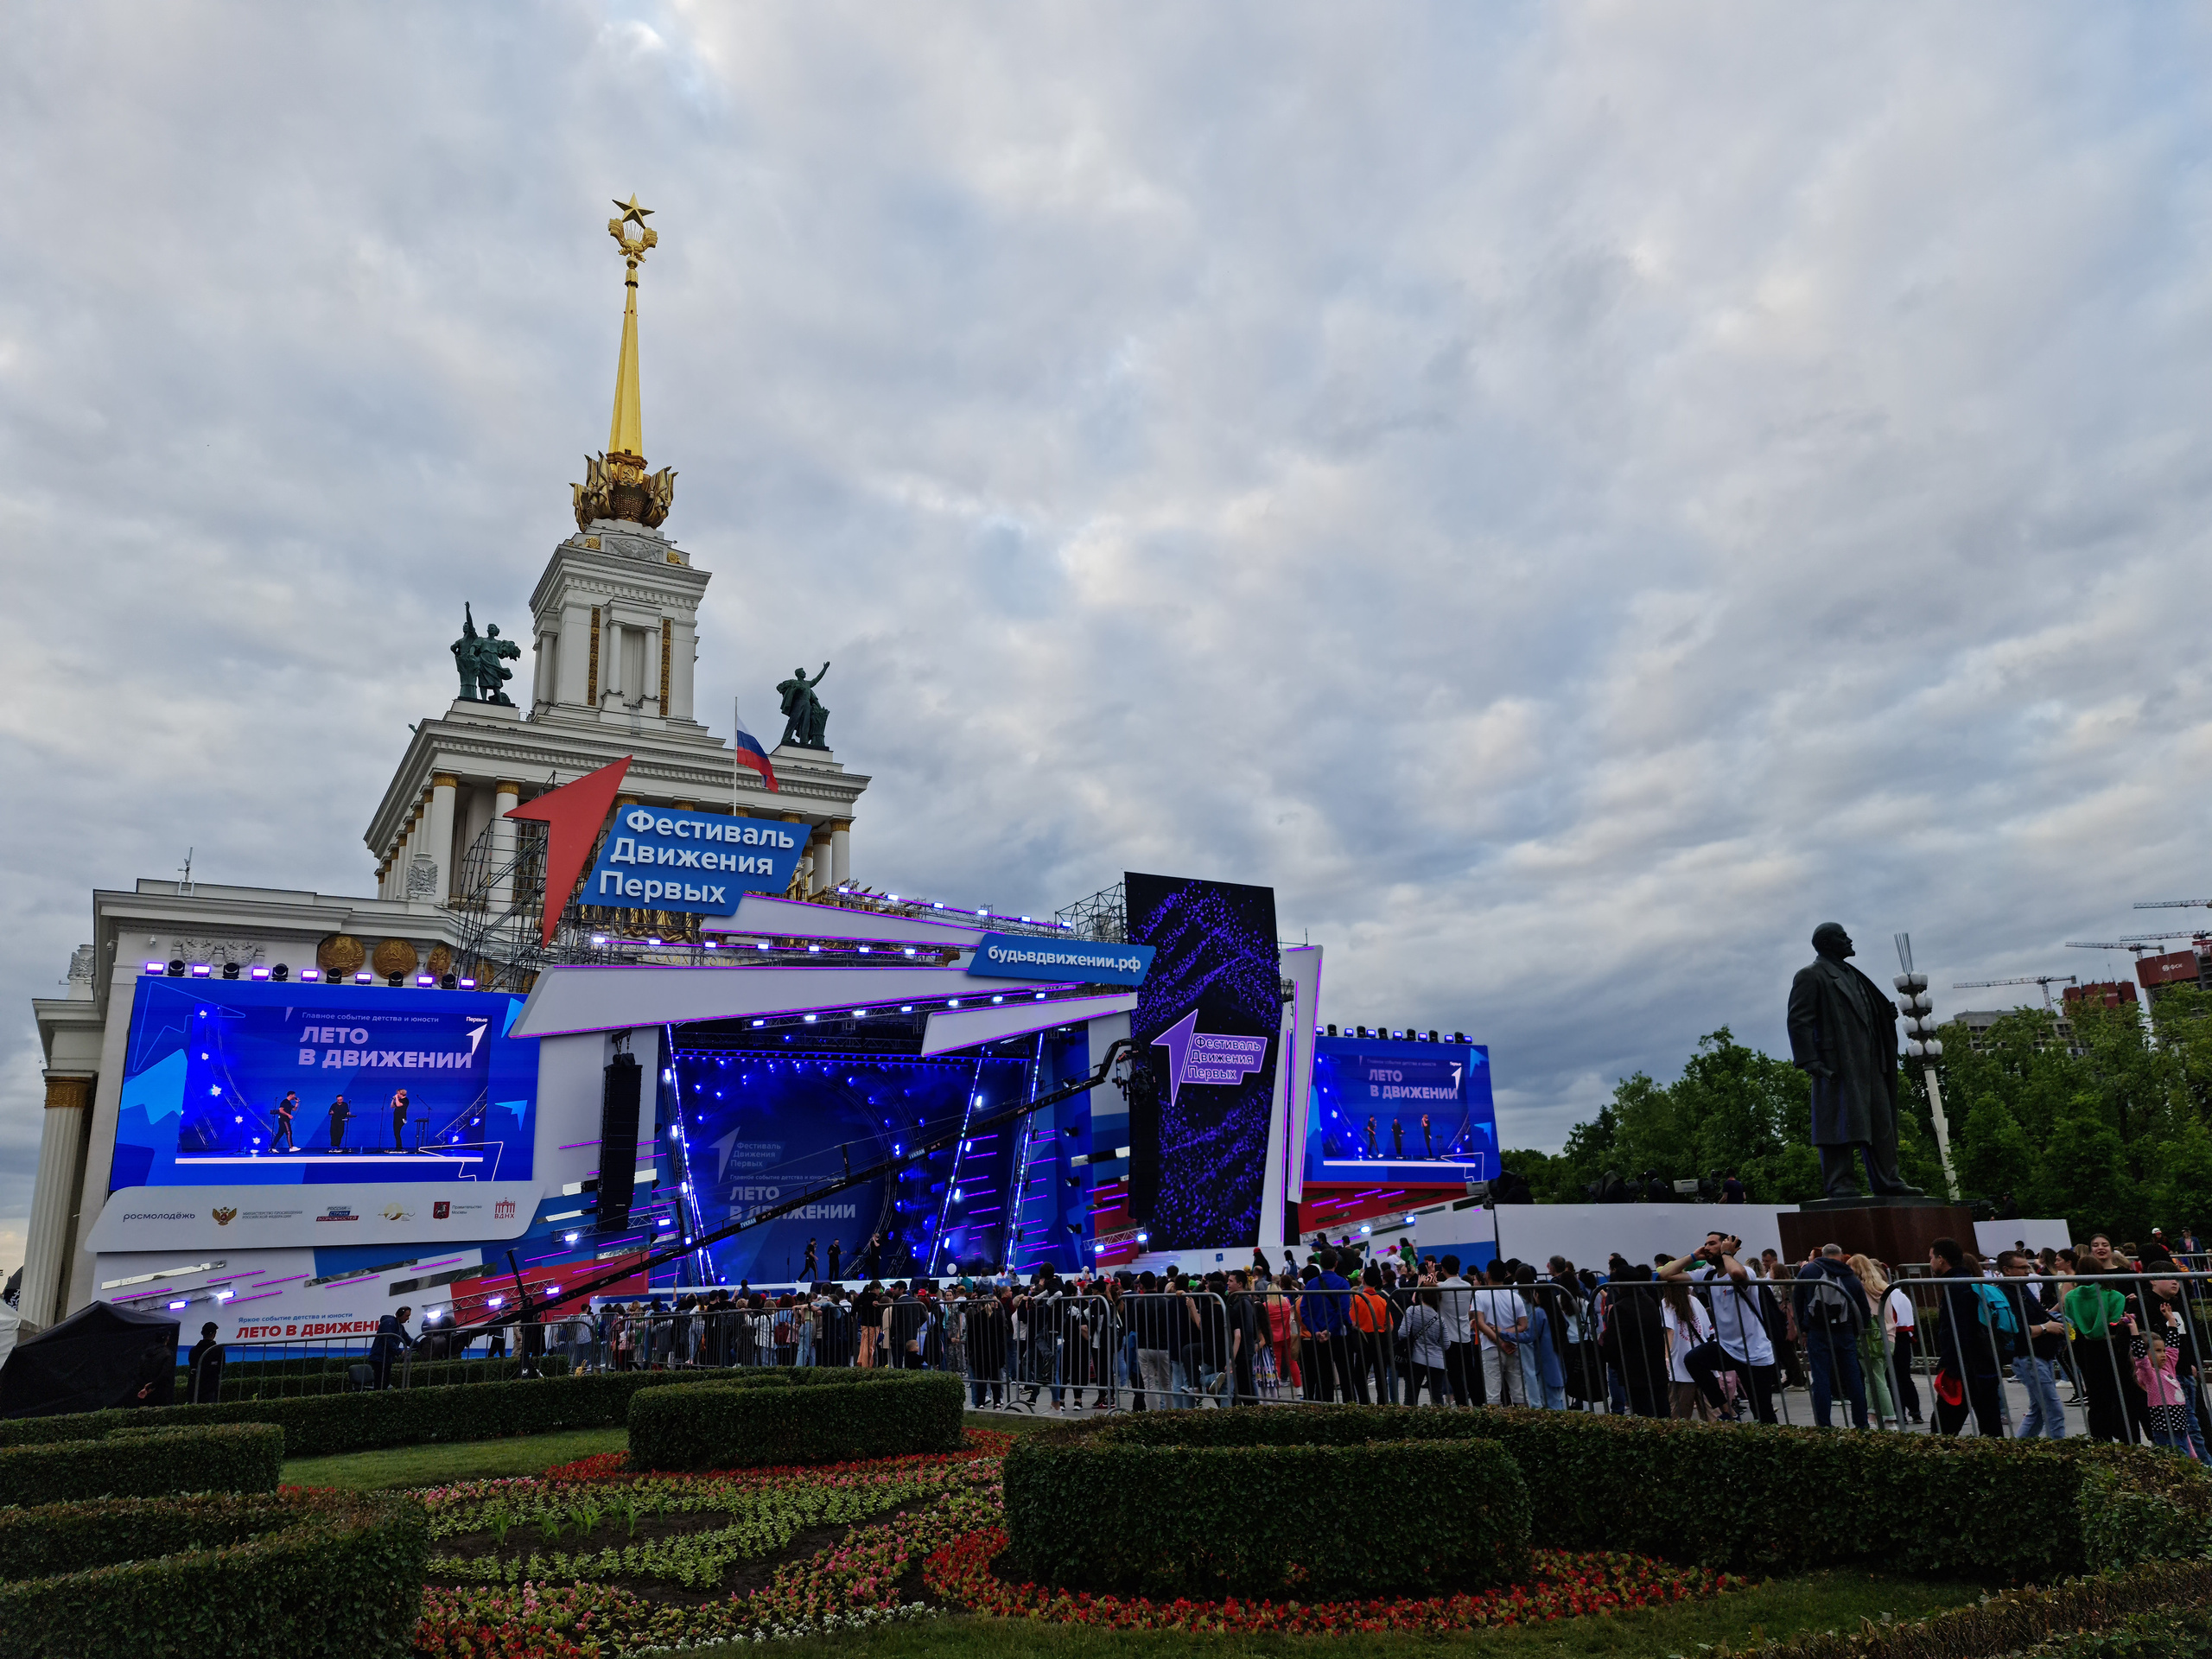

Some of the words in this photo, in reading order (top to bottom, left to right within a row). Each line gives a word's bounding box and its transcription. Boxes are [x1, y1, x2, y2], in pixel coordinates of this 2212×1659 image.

[626, 810, 794, 849] Фестиваль
[610, 837, 773, 875] Движения
[600, 870, 726, 904] Первых
[988, 945, 1141, 973] будьвдвижении.рф
[300, 1026, 369, 1045] ЛЕТО
[1195, 1036, 1261, 1051] Фестиваль
[298, 1048, 315, 1065] В
[321, 1048, 472, 1069] ДВИЖЕНИИ
[1191, 1050, 1254, 1065] Движения
[1188, 1065, 1236, 1081] Первых
[1369, 1069, 1402, 1082] ЛЕТО
[1370, 1084, 1379, 1096] В
[1382, 1085, 1458, 1099] ДВИЖЕНИИ
[730, 1160, 763, 1168] Первых
[730, 1186, 779, 1201] ЛЕТО
[123, 1211, 195, 1222] росмолодёжь
[730, 1206, 742, 1220] В
[236, 1325, 282, 1339] ЛЕТО
[286, 1325, 297, 1336] В
